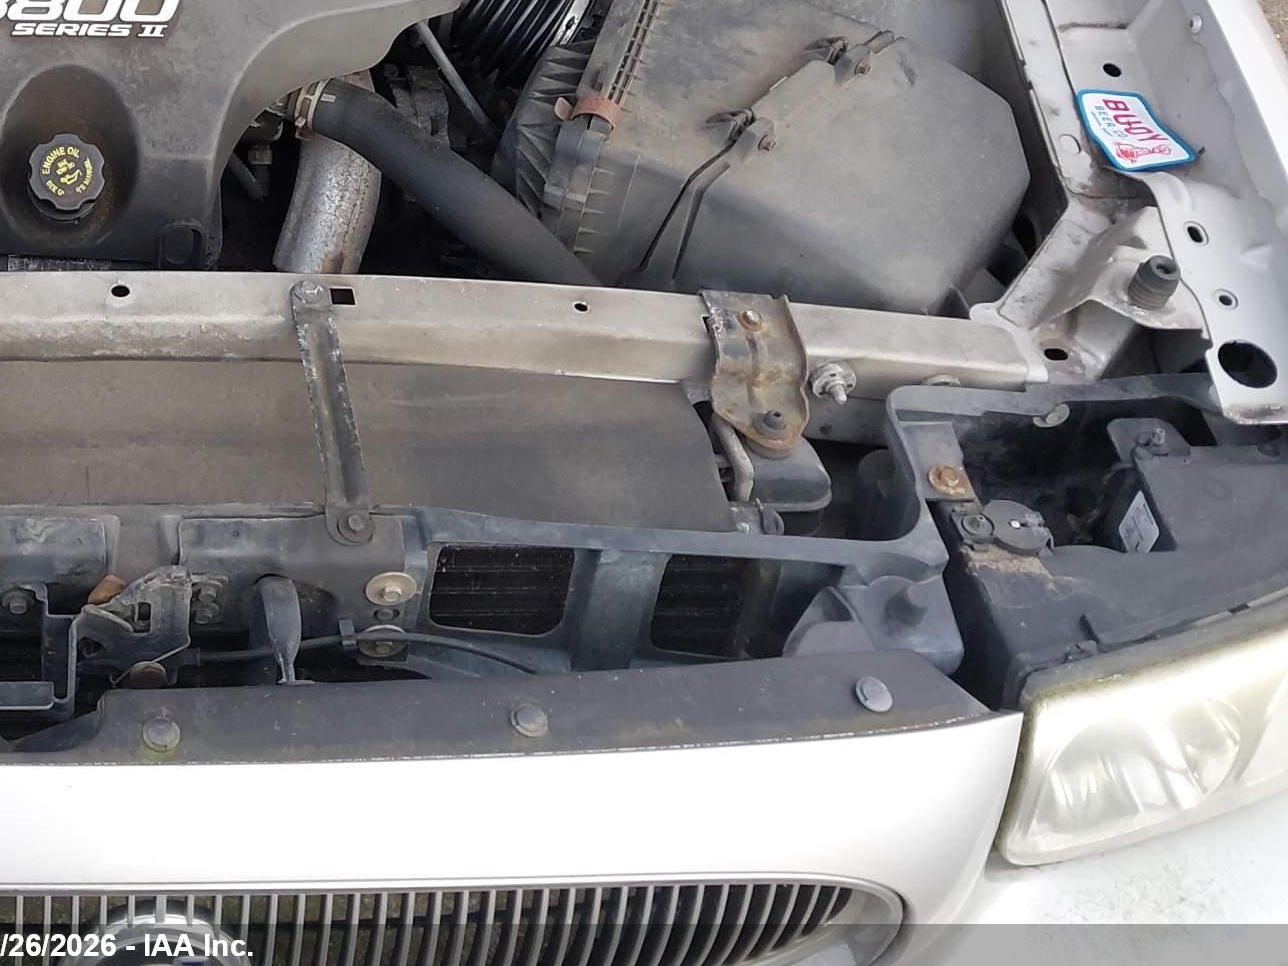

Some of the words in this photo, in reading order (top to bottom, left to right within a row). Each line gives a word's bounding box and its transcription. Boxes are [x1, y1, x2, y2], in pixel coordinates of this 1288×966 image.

[11, 22, 132, 37] SERIES
[137, 24, 168, 38] II
[1094, 105, 1116, 128] BEER
[1102, 98, 1169, 142] BUOY
[42, 146, 66, 175] ENGINE
[67, 146, 81, 159] OIL
